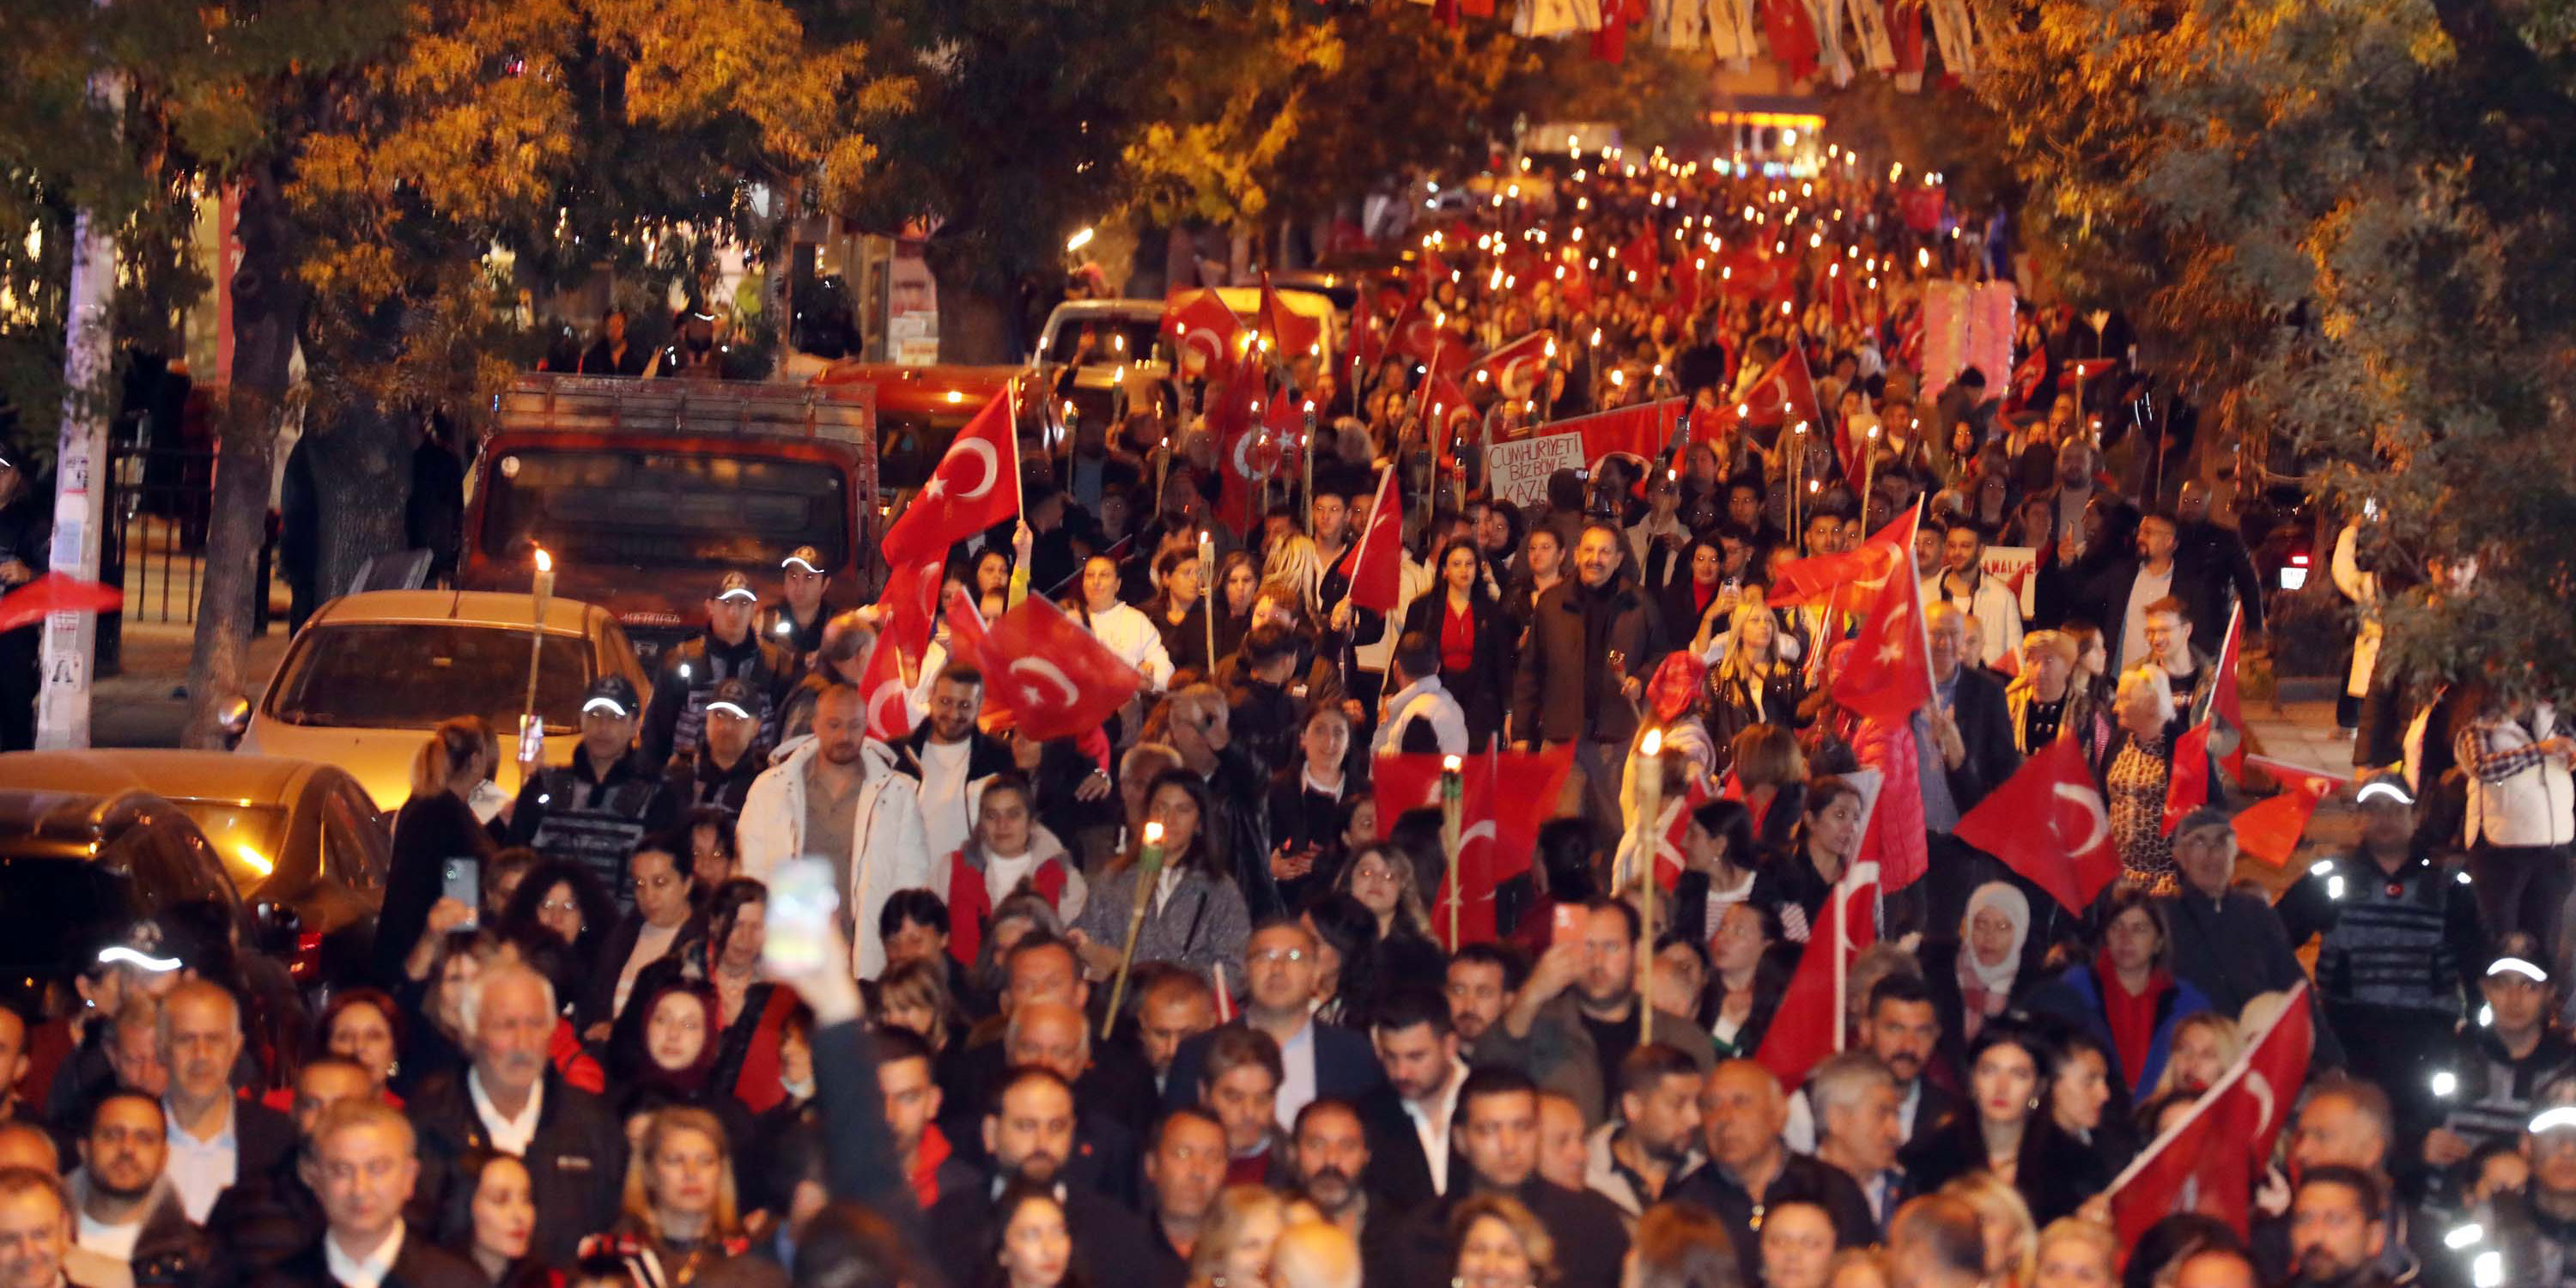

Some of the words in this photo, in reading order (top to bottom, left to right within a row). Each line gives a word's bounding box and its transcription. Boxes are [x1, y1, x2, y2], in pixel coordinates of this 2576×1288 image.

[1489, 433, 1579, 469] CUMHURİYETİ
[1510, 463, 1533, 481] BİZ
[1504, 479, 1548, 503] KAZA
